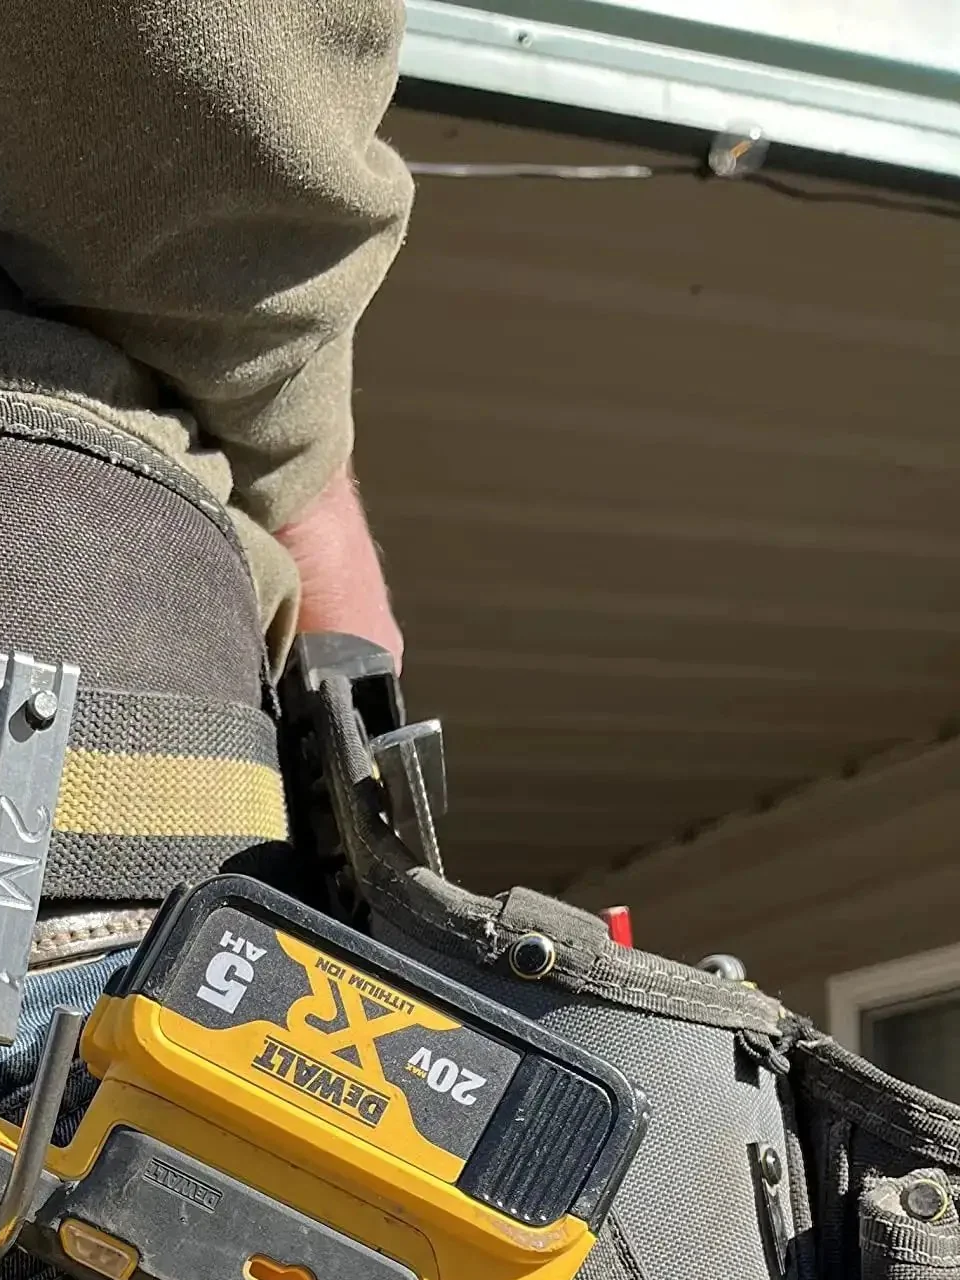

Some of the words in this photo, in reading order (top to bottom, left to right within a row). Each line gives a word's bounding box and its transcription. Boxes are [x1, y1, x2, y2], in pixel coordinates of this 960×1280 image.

[218, 929, 267, 965] AH
[192, 945, 258, 1015] 5
[313, 955, 347, 980] ION
[346, 971, 415, 1016] LITHIUM
[404, 1062, 427, 1079] MAX
[407, 1043, 488, 1109] 20V
